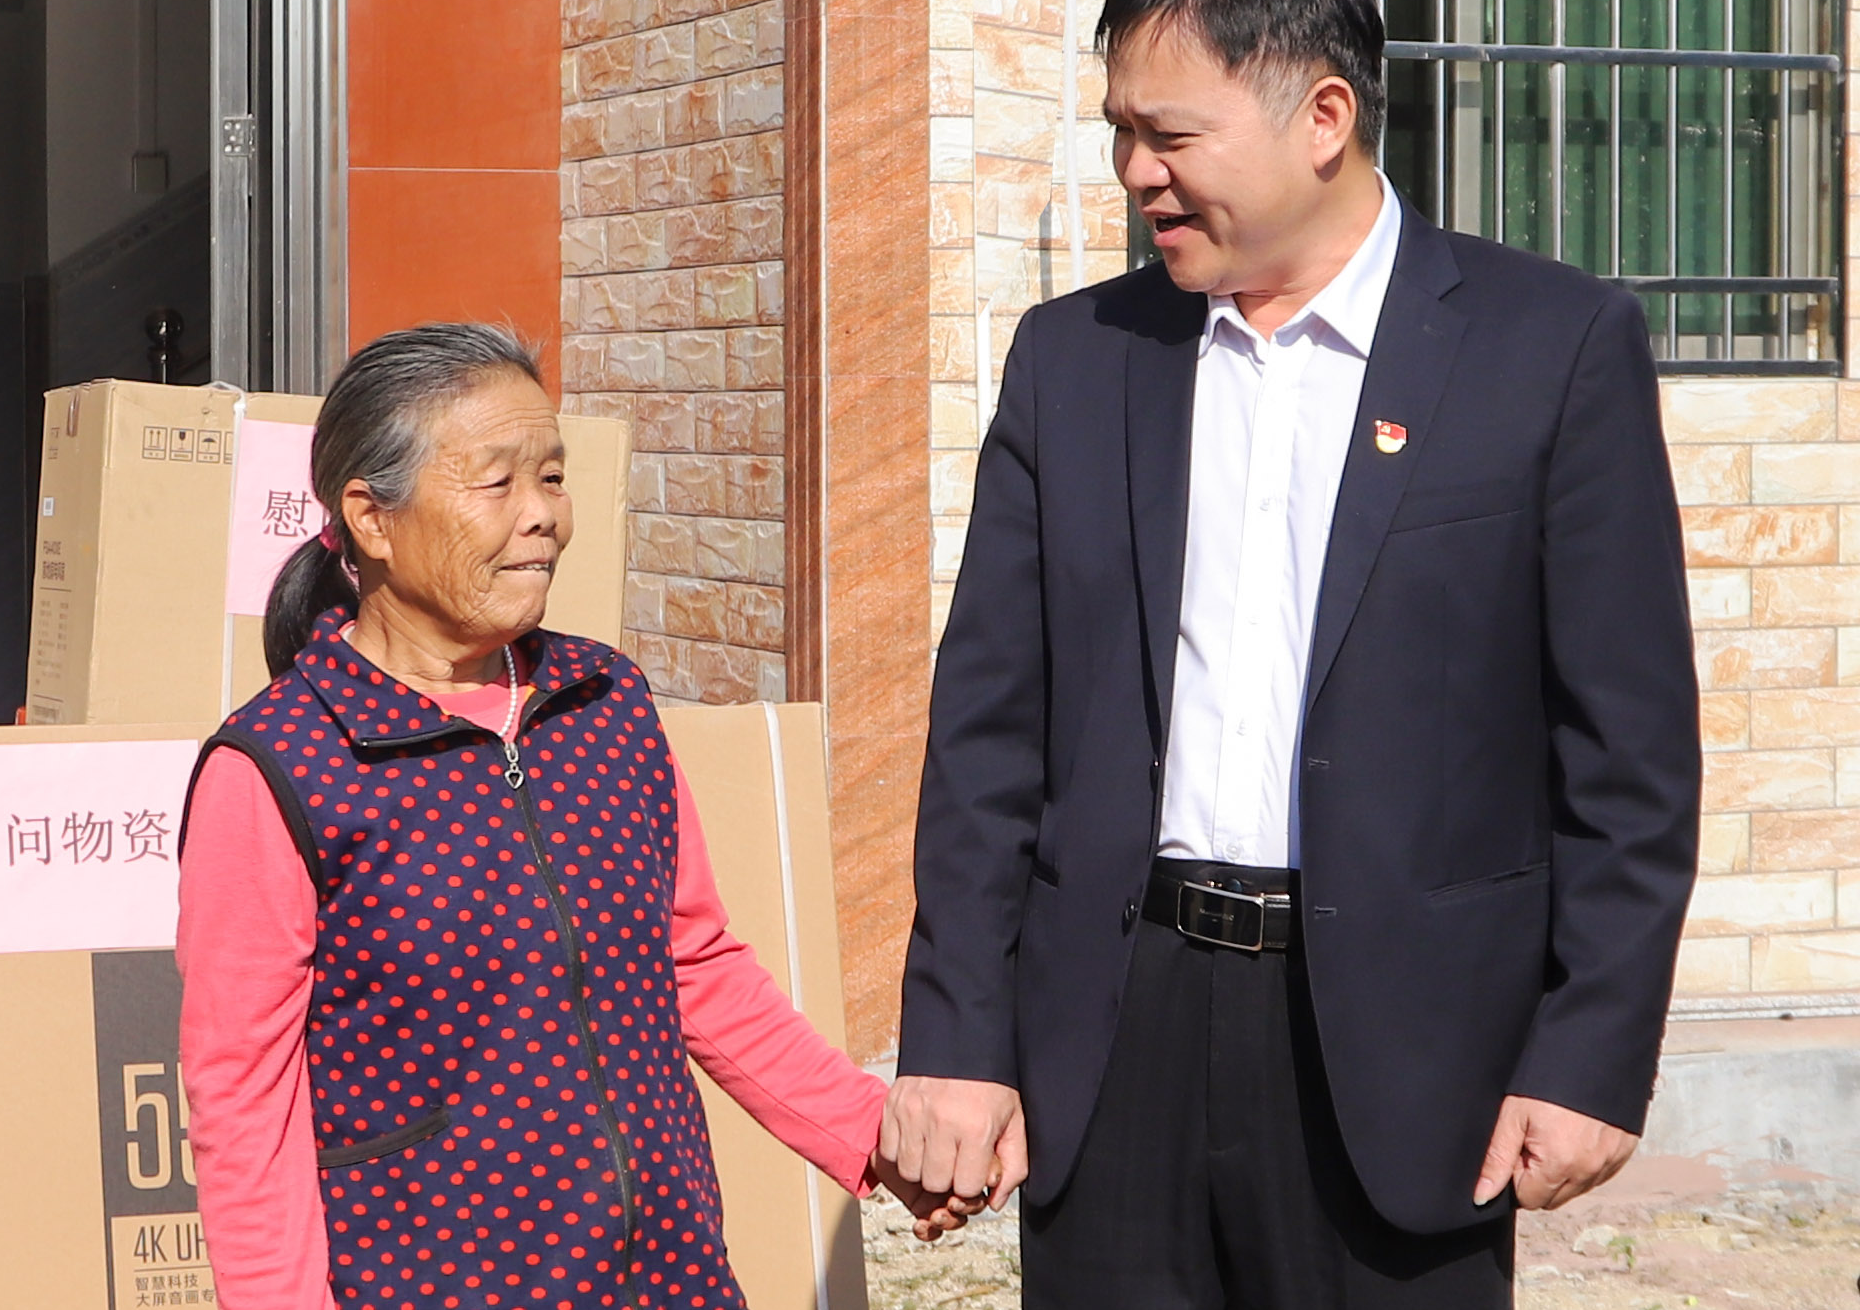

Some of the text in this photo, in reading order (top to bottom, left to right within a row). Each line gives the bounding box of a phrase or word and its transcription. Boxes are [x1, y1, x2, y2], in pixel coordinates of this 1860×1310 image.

[262, 489, 327, 538] 慰
[133, 1224, 168, 1264] 4K
[135, 1273, 199, 1291] 智慧科技
[135, 1288, 215, 1308] 大屏音画专
